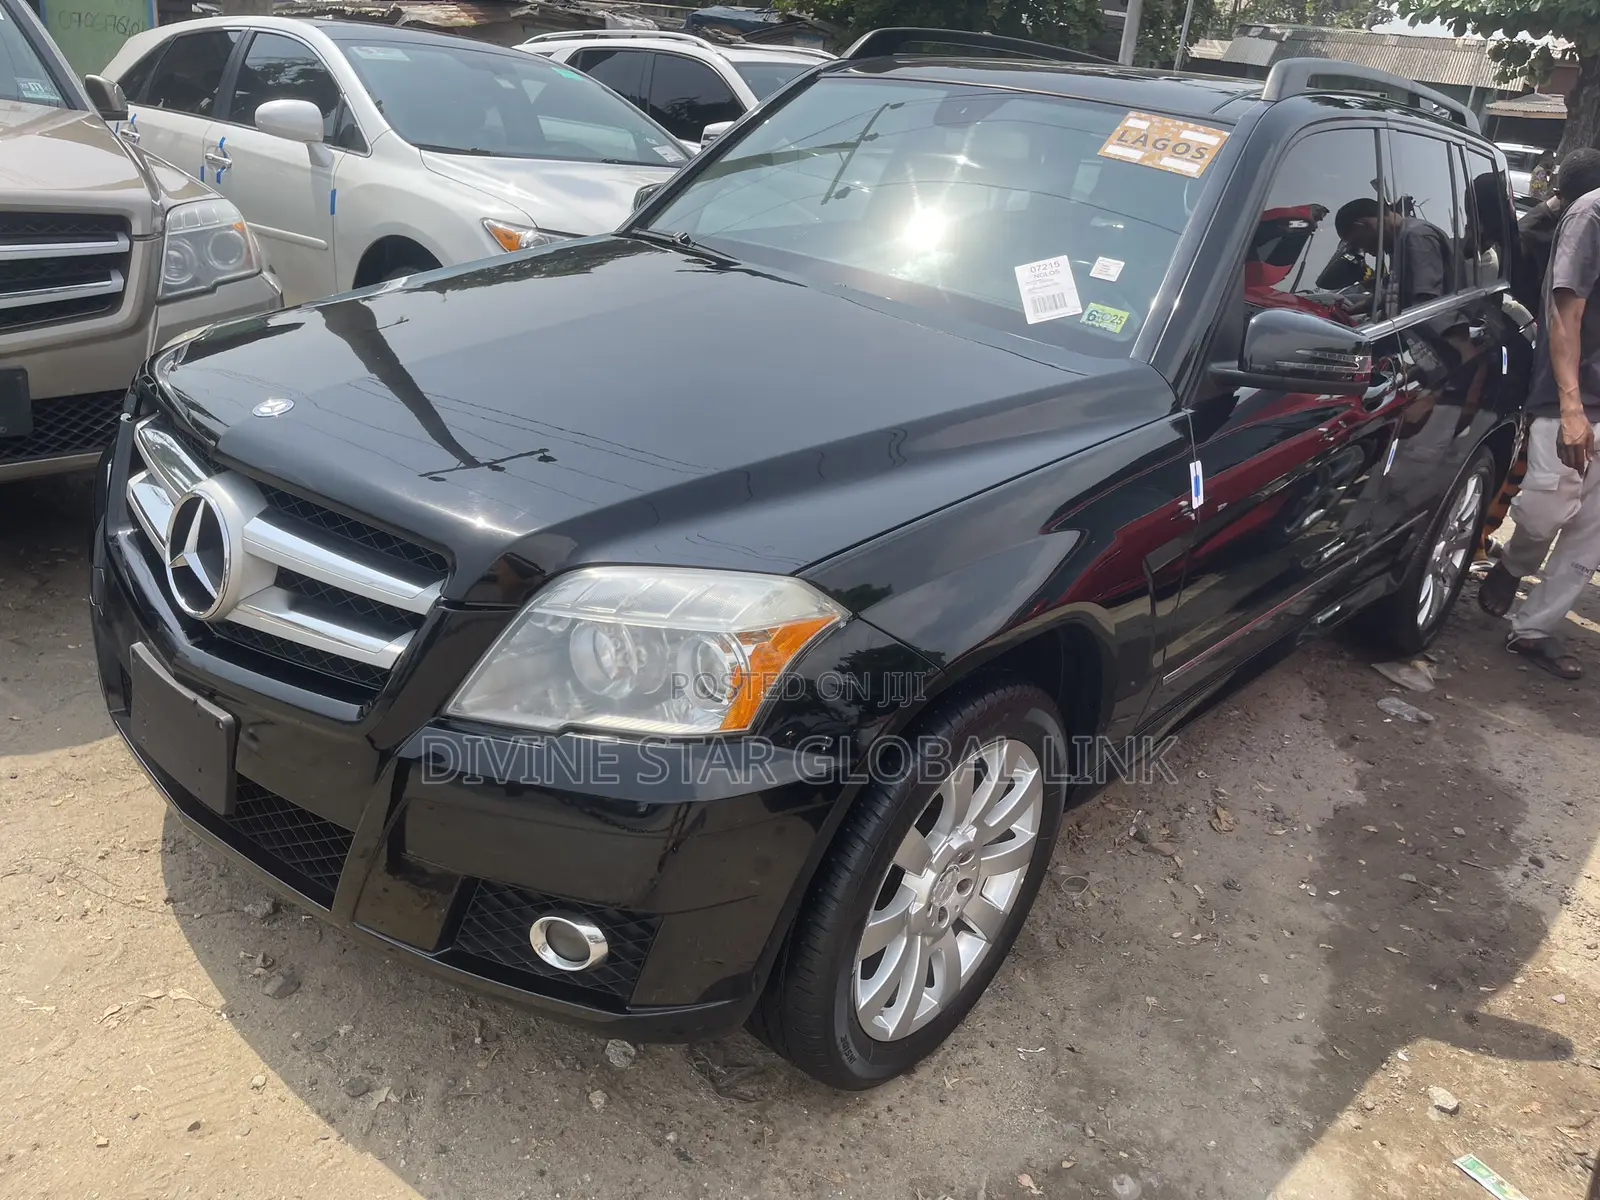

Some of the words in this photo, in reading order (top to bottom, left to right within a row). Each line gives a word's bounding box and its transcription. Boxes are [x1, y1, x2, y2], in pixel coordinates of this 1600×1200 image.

[1116, 129, 1209, 160] LAGOS
[1030, 261, 1060, 273] 07215
[1087, 309, 1099, 322] 6
[1110, 314, 1125, 325] 25
